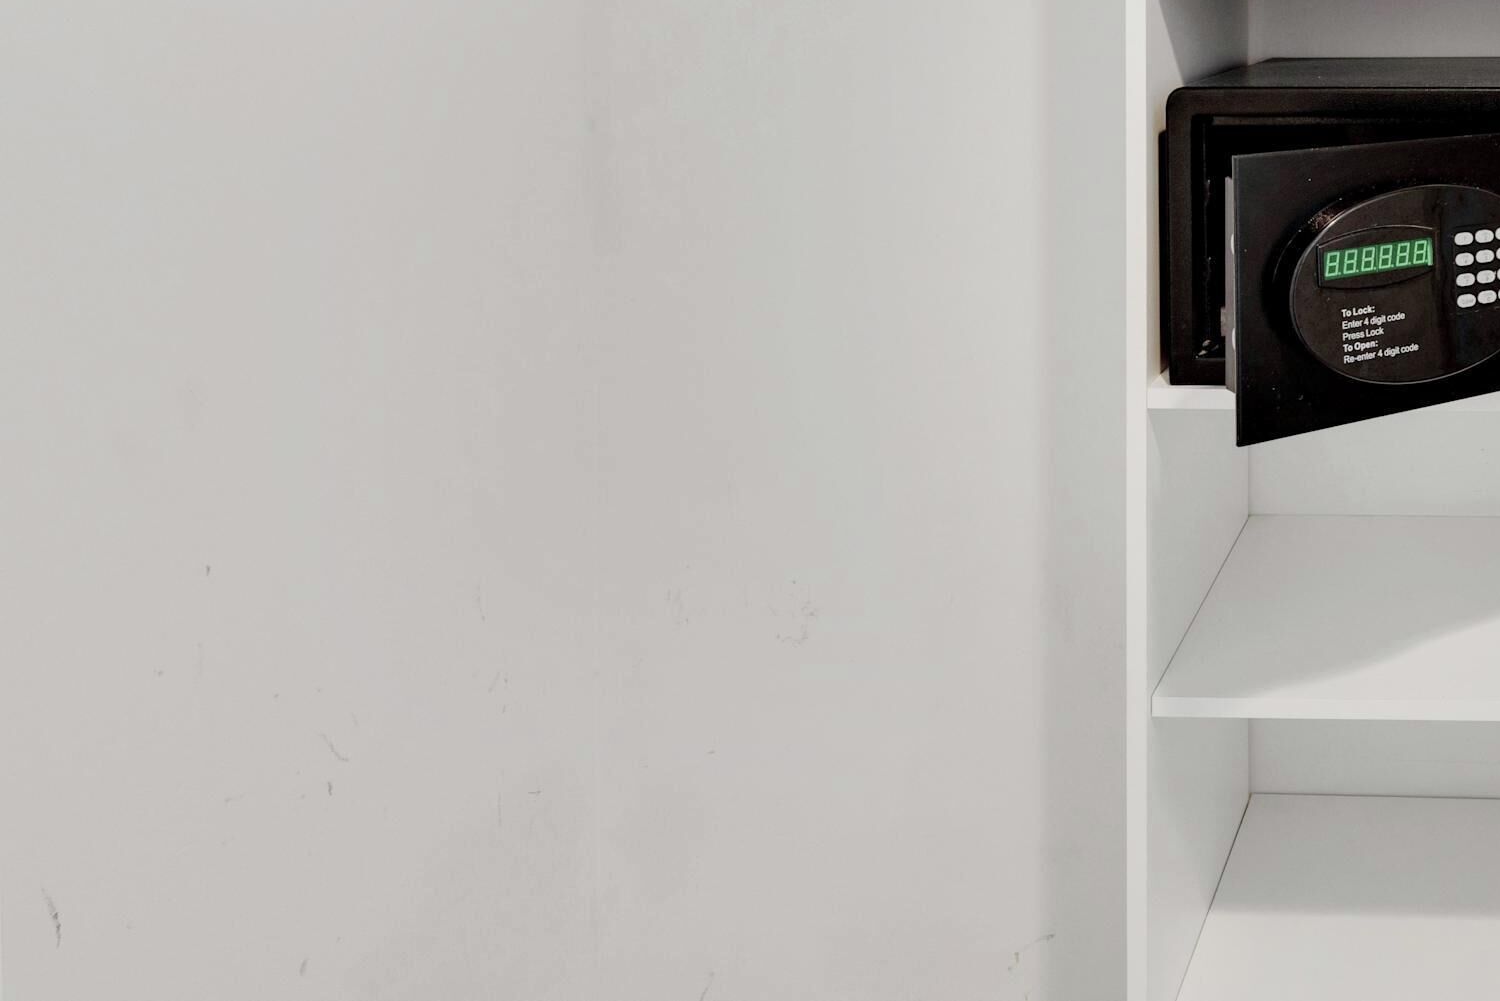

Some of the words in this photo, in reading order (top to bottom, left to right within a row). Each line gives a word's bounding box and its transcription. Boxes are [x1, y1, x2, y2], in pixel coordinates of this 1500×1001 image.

[1341, 309, 1352, 317] To
[1352, 305, 1375, 316] Lock:
[1341, 320, 1363, 330] Enter
[1363, 317, 1369, 325] 4
[1370, 314, 1386, 325] digit
[1386, 312, 1406, 322] code
[1342, 331, 1365, 341] Press
[1365, 327, 1385, 337] Lock
[1342, 343, 1353, 352] To
[1353, 340, 1379, 352] Open:
[1343, 352, 1376, 364] Re-enter
[1377, 349, 1383, 358] 4
[1383, 346, 1400, 357] digit
[1400, 343, 1420, 353] code
